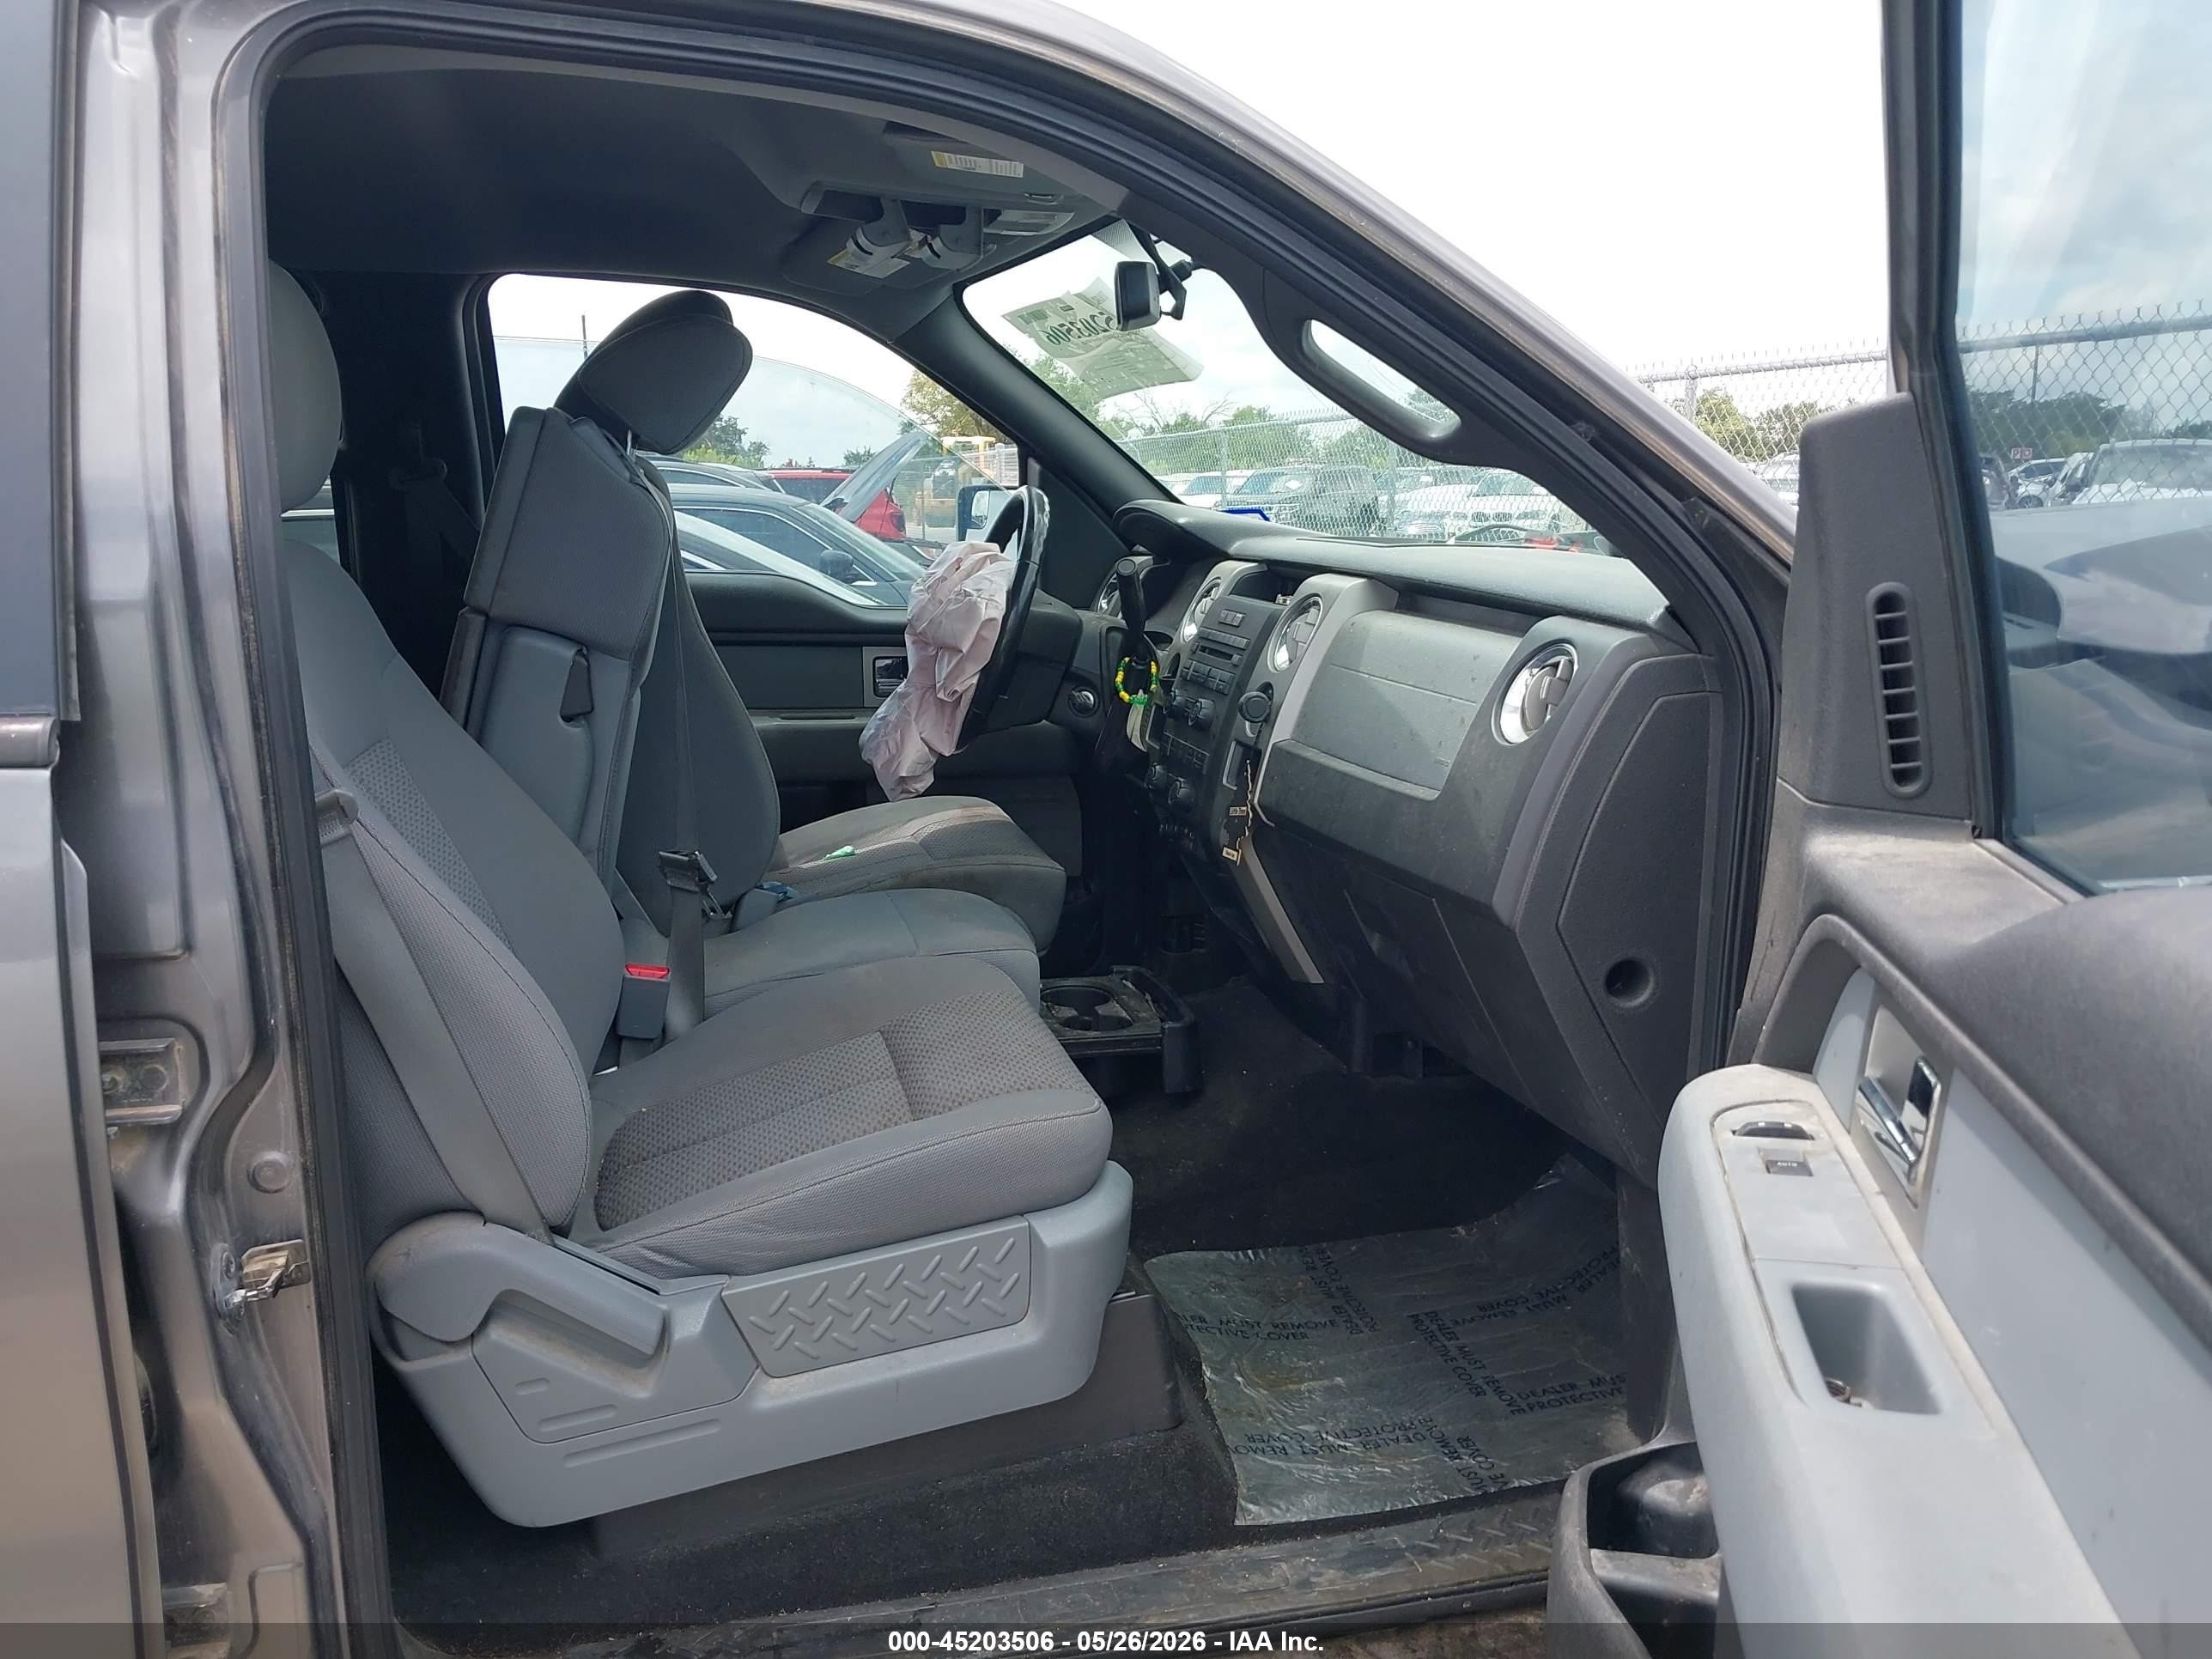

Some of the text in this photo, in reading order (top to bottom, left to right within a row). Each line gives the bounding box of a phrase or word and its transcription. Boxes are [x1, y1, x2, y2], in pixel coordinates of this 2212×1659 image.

[1476, 1295, 1529, 1312] COVER
[1425, 1310, 1460, 1341] DEALER
[1454, 1345, 1487, 1371] MUST
[1407, 1313, 1487, 1398] PROTECTIVE COVER
[1516, 1381, 1579, 1401] DEALER
[1243, 1431, 1306, 1444] COVER
[1362, 1431, 1425, 1450] DEALER
[1456, 1436, 1495, 1470] COVER
